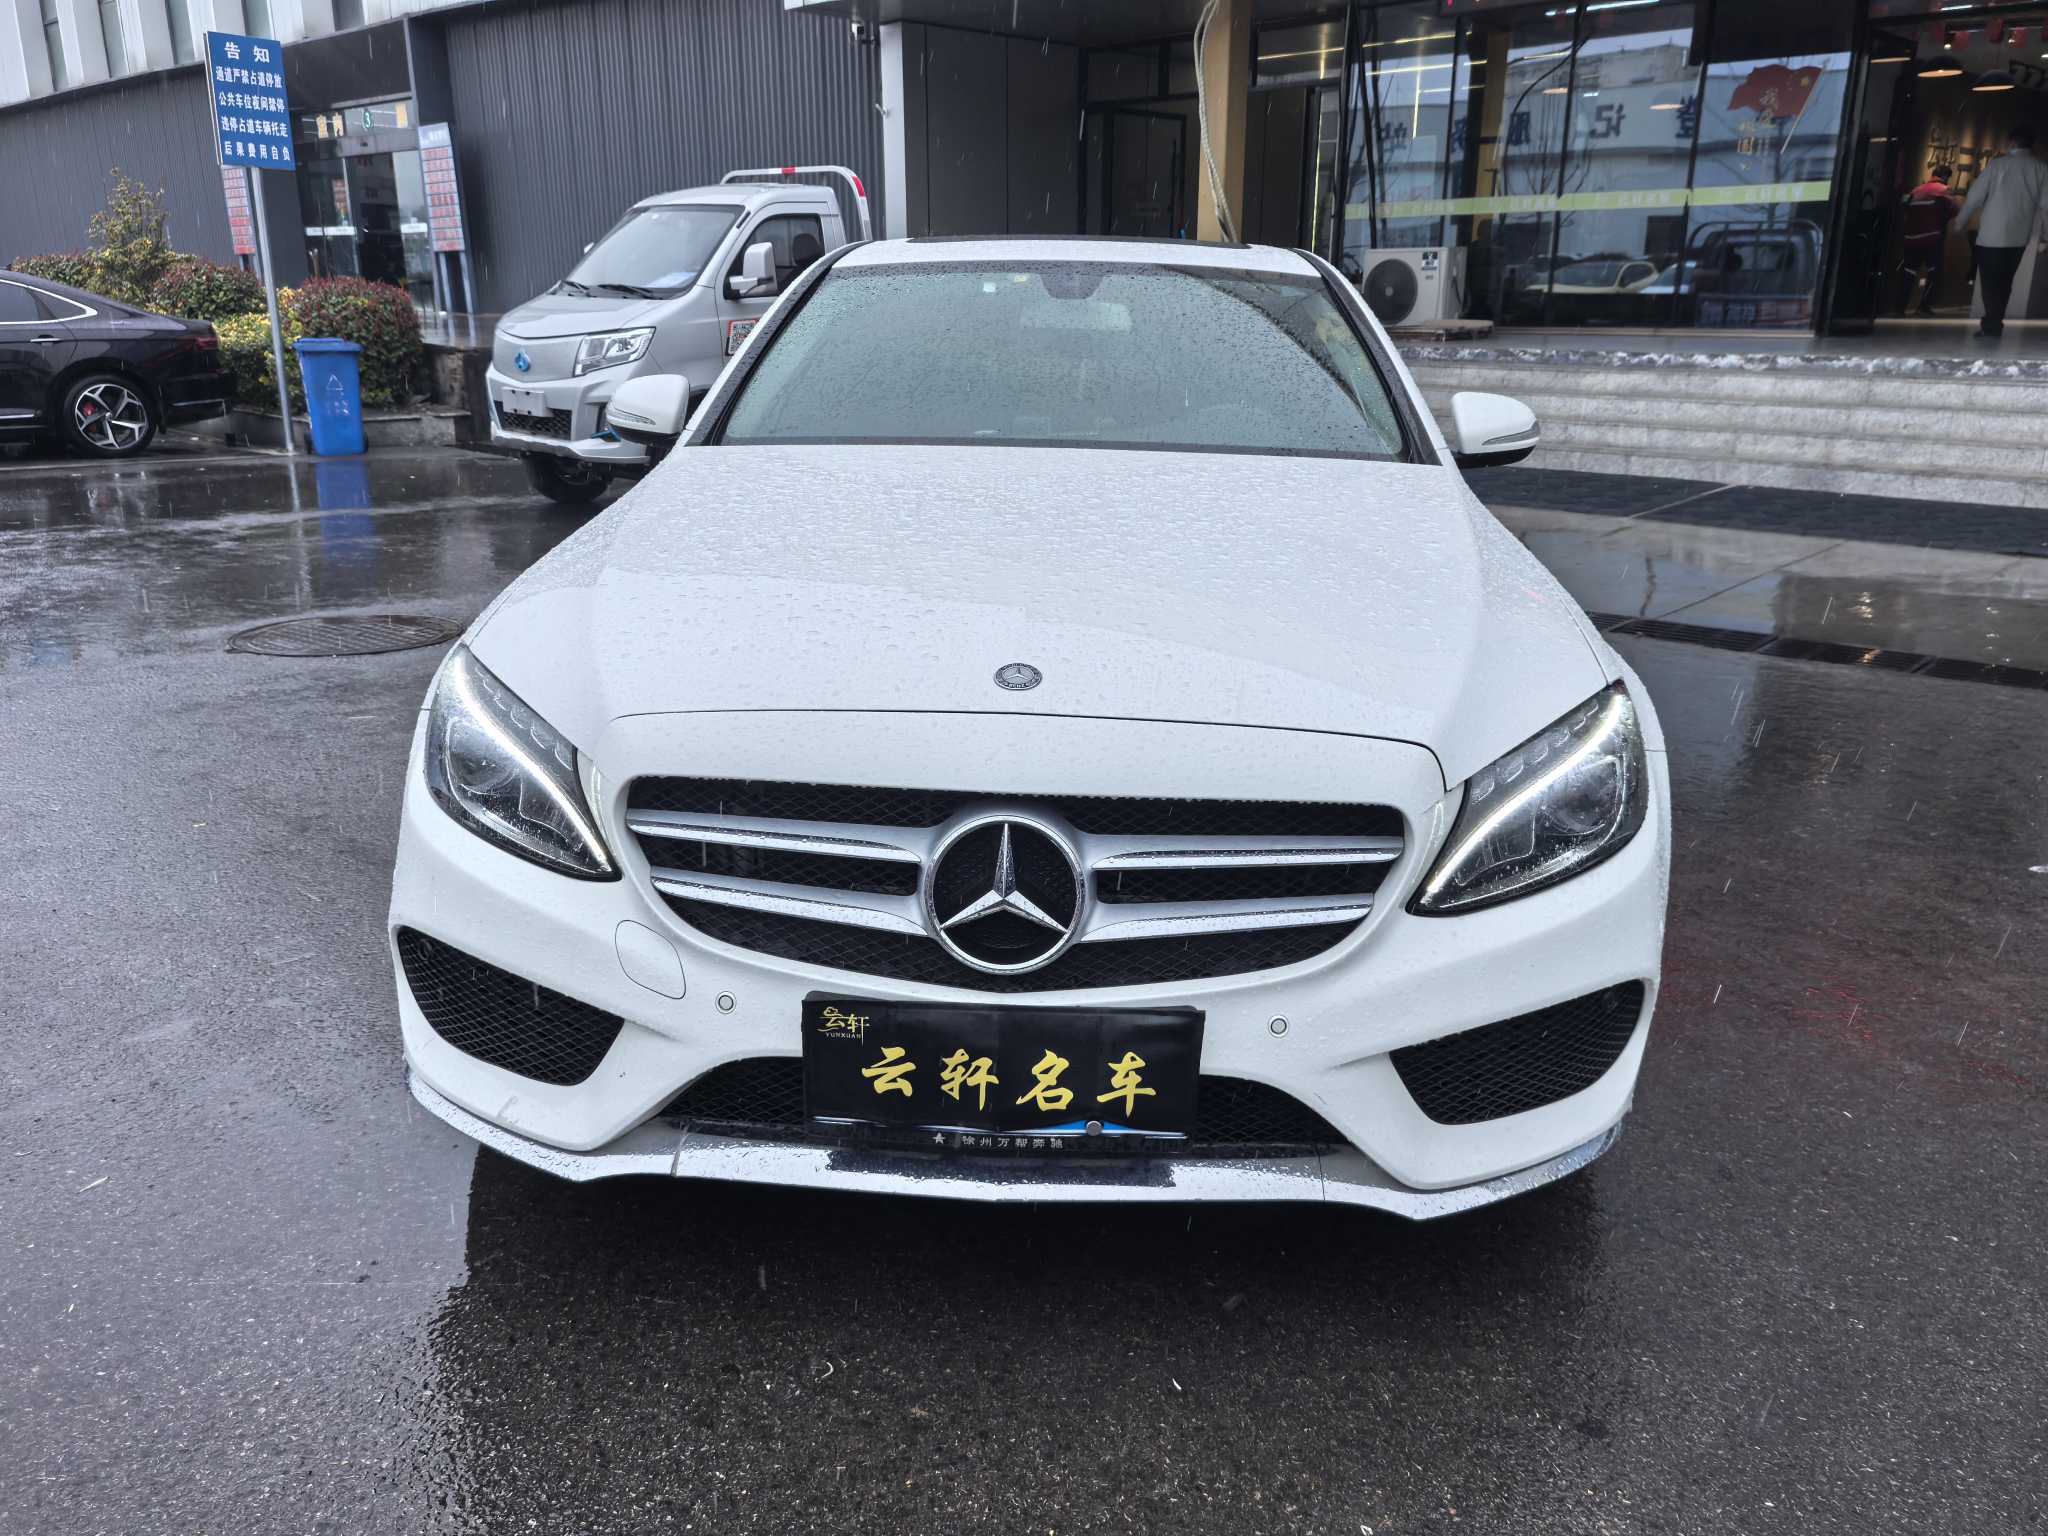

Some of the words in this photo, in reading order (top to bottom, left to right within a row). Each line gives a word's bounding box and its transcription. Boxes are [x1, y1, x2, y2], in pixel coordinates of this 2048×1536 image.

[224, 41, 270, 63] 告知
[224, 141, 291, 161] 后果费用自负
[825, 1031, 862, 1040] YUNXUAN
[861, 1046, 1157, 1118] 云轩名车
